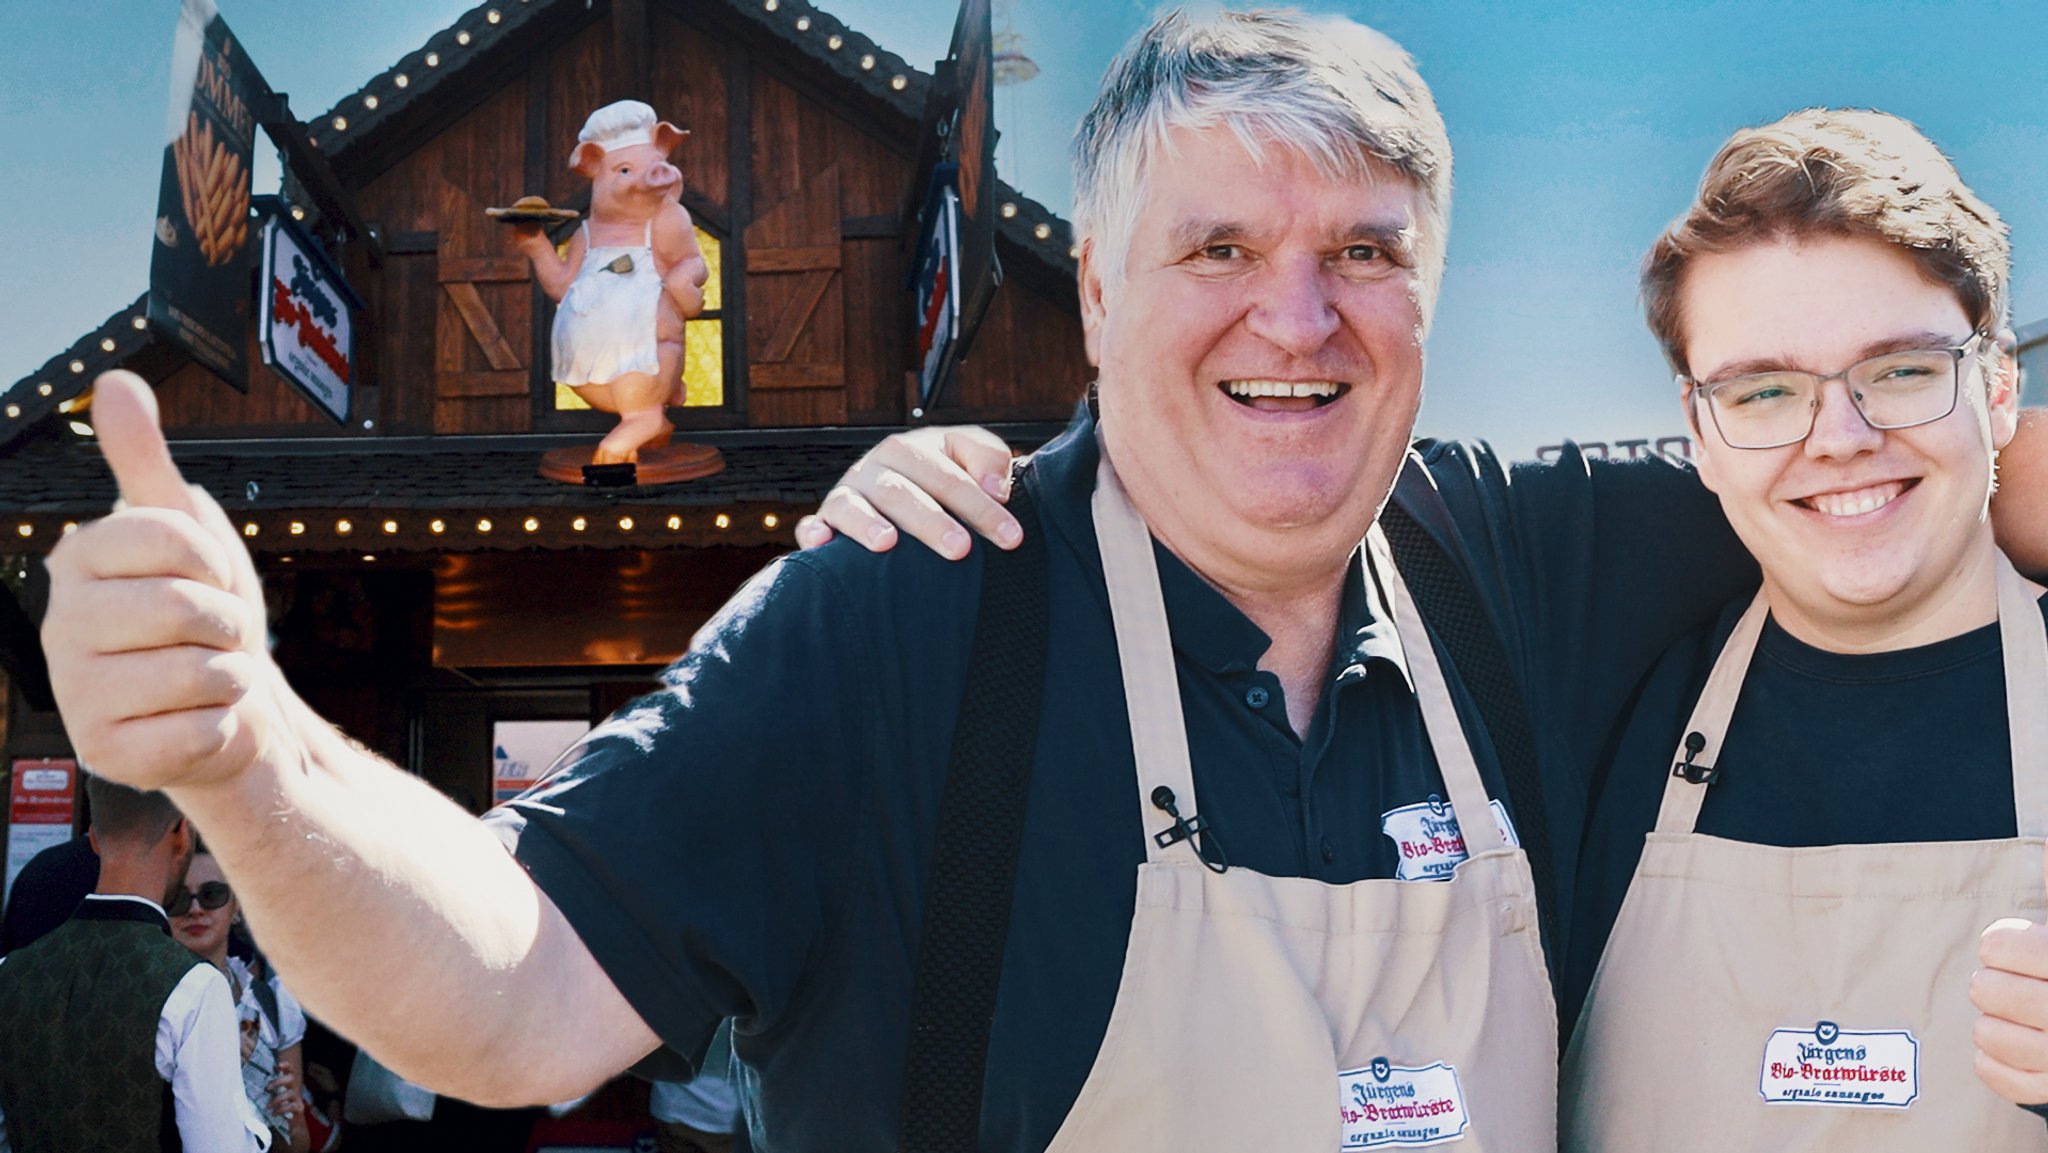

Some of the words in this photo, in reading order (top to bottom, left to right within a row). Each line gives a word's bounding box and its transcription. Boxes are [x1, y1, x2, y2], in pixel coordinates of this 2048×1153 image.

[1420, 816, 1459, 838] Jürg
[1796, 1042, 1866, 1065] Jürgens
[1771, 1062, 1907, 1082] Bio-Bratwürste
[1351, 1082, 1416, 1106] Jürgens
[1782, 1087, 1821, 1101] organic
[1824, 1090, 1885, 1102] sausages
[1350, 1129, 1395, 1143] organic
